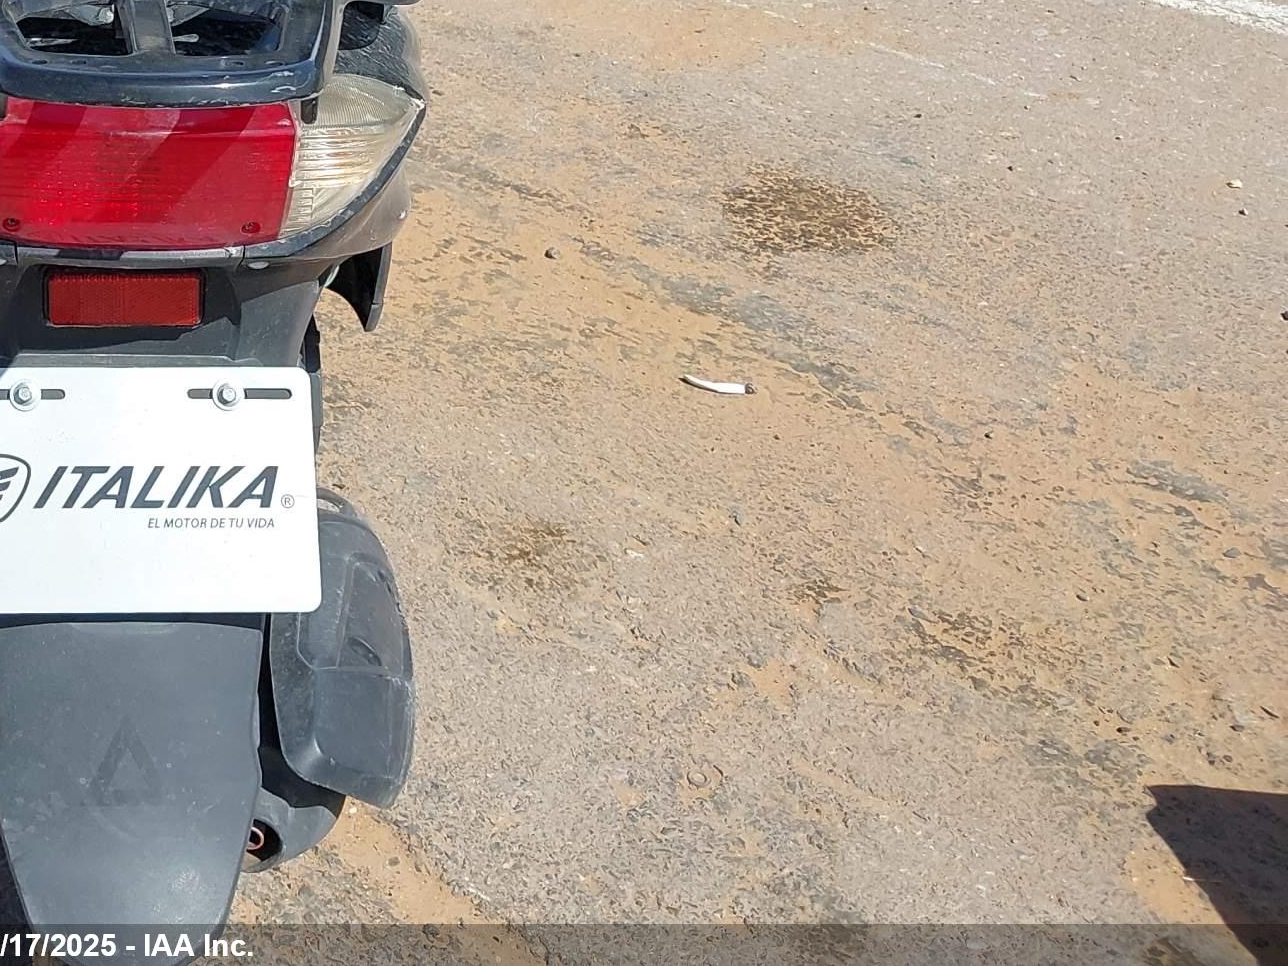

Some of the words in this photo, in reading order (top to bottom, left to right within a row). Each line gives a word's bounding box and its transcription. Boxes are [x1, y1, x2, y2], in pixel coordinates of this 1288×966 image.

[34, 465, 278, 509] ITALIKA
[148, 518, 160, 529] EL
[163, 518, 207, 529] MOTOR
[210, 518, 226, 529] DE
[228, 518, 244, 529] TU
[247, 518, 275, 529] VIDA
